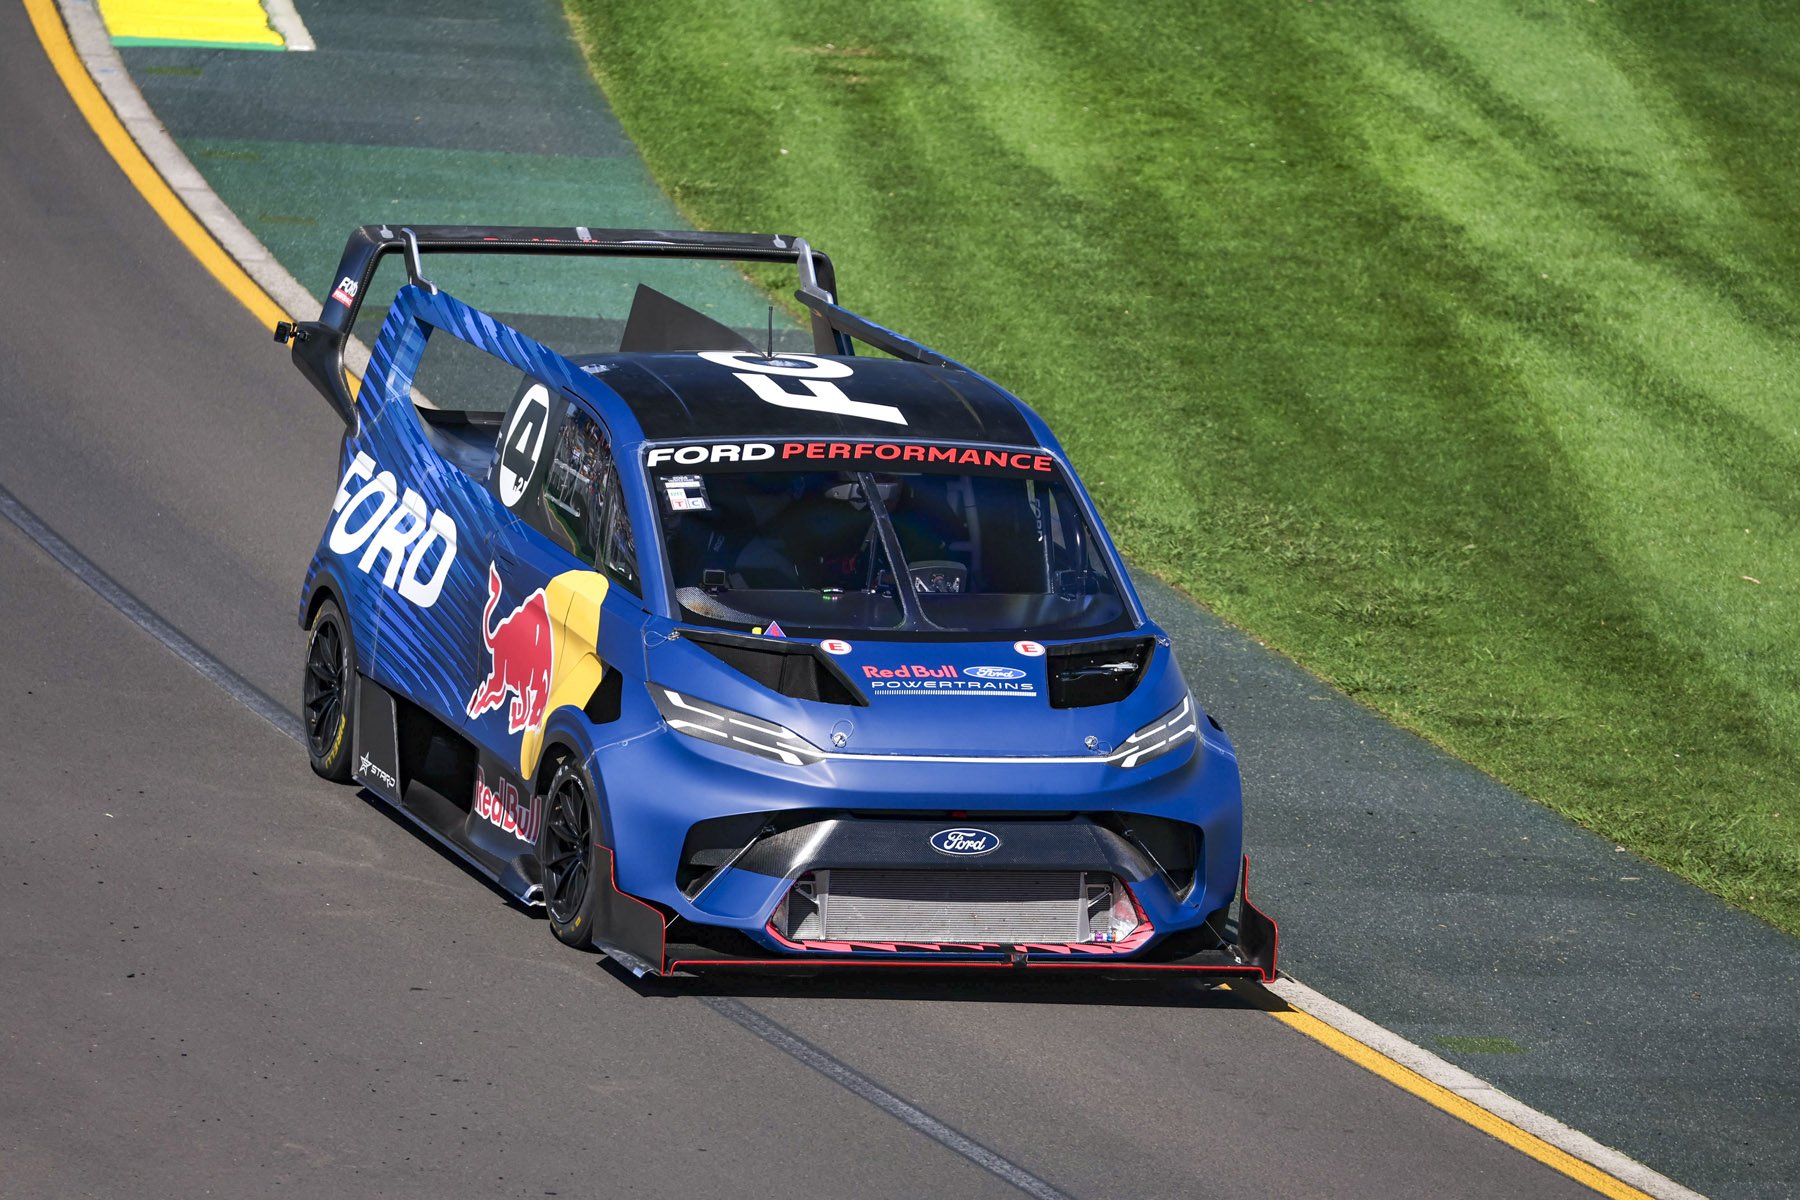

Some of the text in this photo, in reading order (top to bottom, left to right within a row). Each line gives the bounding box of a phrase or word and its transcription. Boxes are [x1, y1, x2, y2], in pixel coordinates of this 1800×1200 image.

[502, 398, 548, 483] 4
[647, 443, 1053, 472] FORD PERFORMANCE
[329, 450, 457, 608] FORD
[828, 642, 844, 651] E
[1021, 644, 1038, 653] E
[862, 665, 1014, 678] Red Bull Ford
[872, 680, 1034, 690] POWERTRAINS
[370, 764, 396, 788] STARD
[475, 764, 542, 846] Red Bull
[943, 831, 987, 850] Ford
